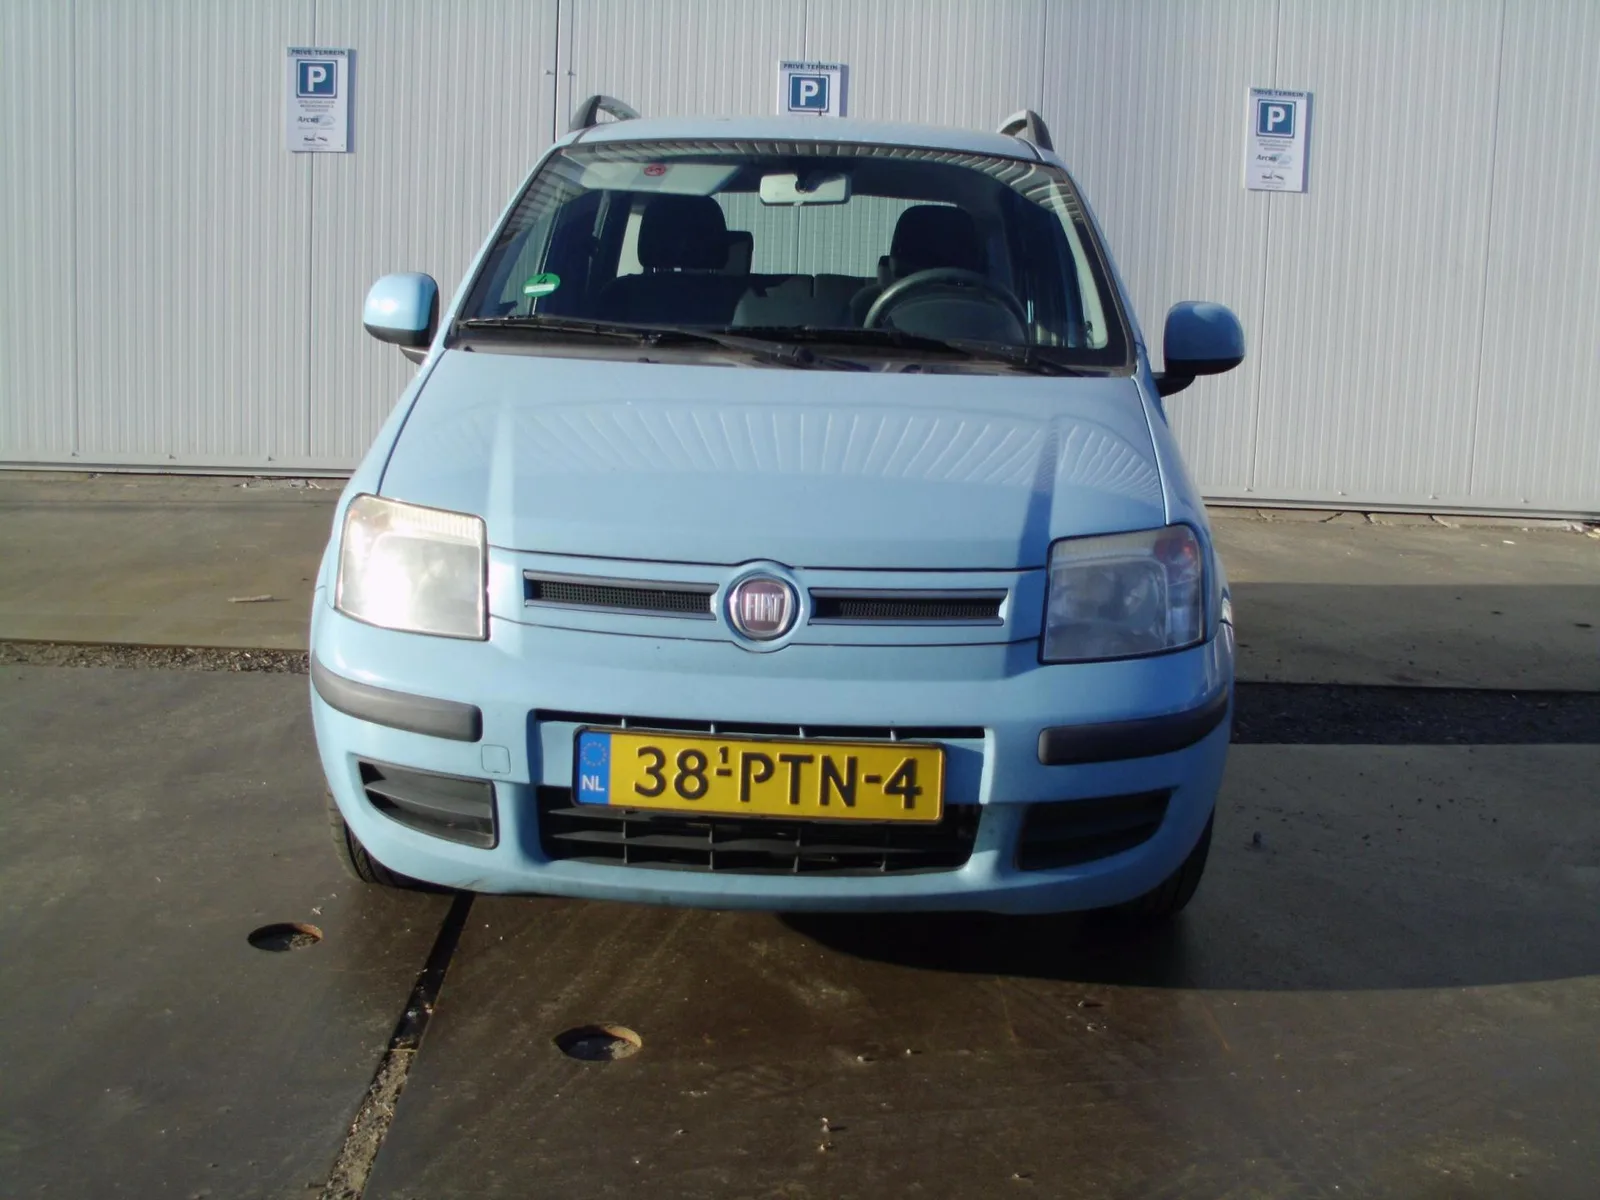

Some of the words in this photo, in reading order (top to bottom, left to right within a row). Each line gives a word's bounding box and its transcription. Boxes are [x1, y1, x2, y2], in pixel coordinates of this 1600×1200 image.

[307, 66, 327, 92] P
[800, 80, 819, 106] P
[1267, 106, 1286, 131] P
[745, 592, 784, 623] FIAT
[581, 774, 605, 792] NL
